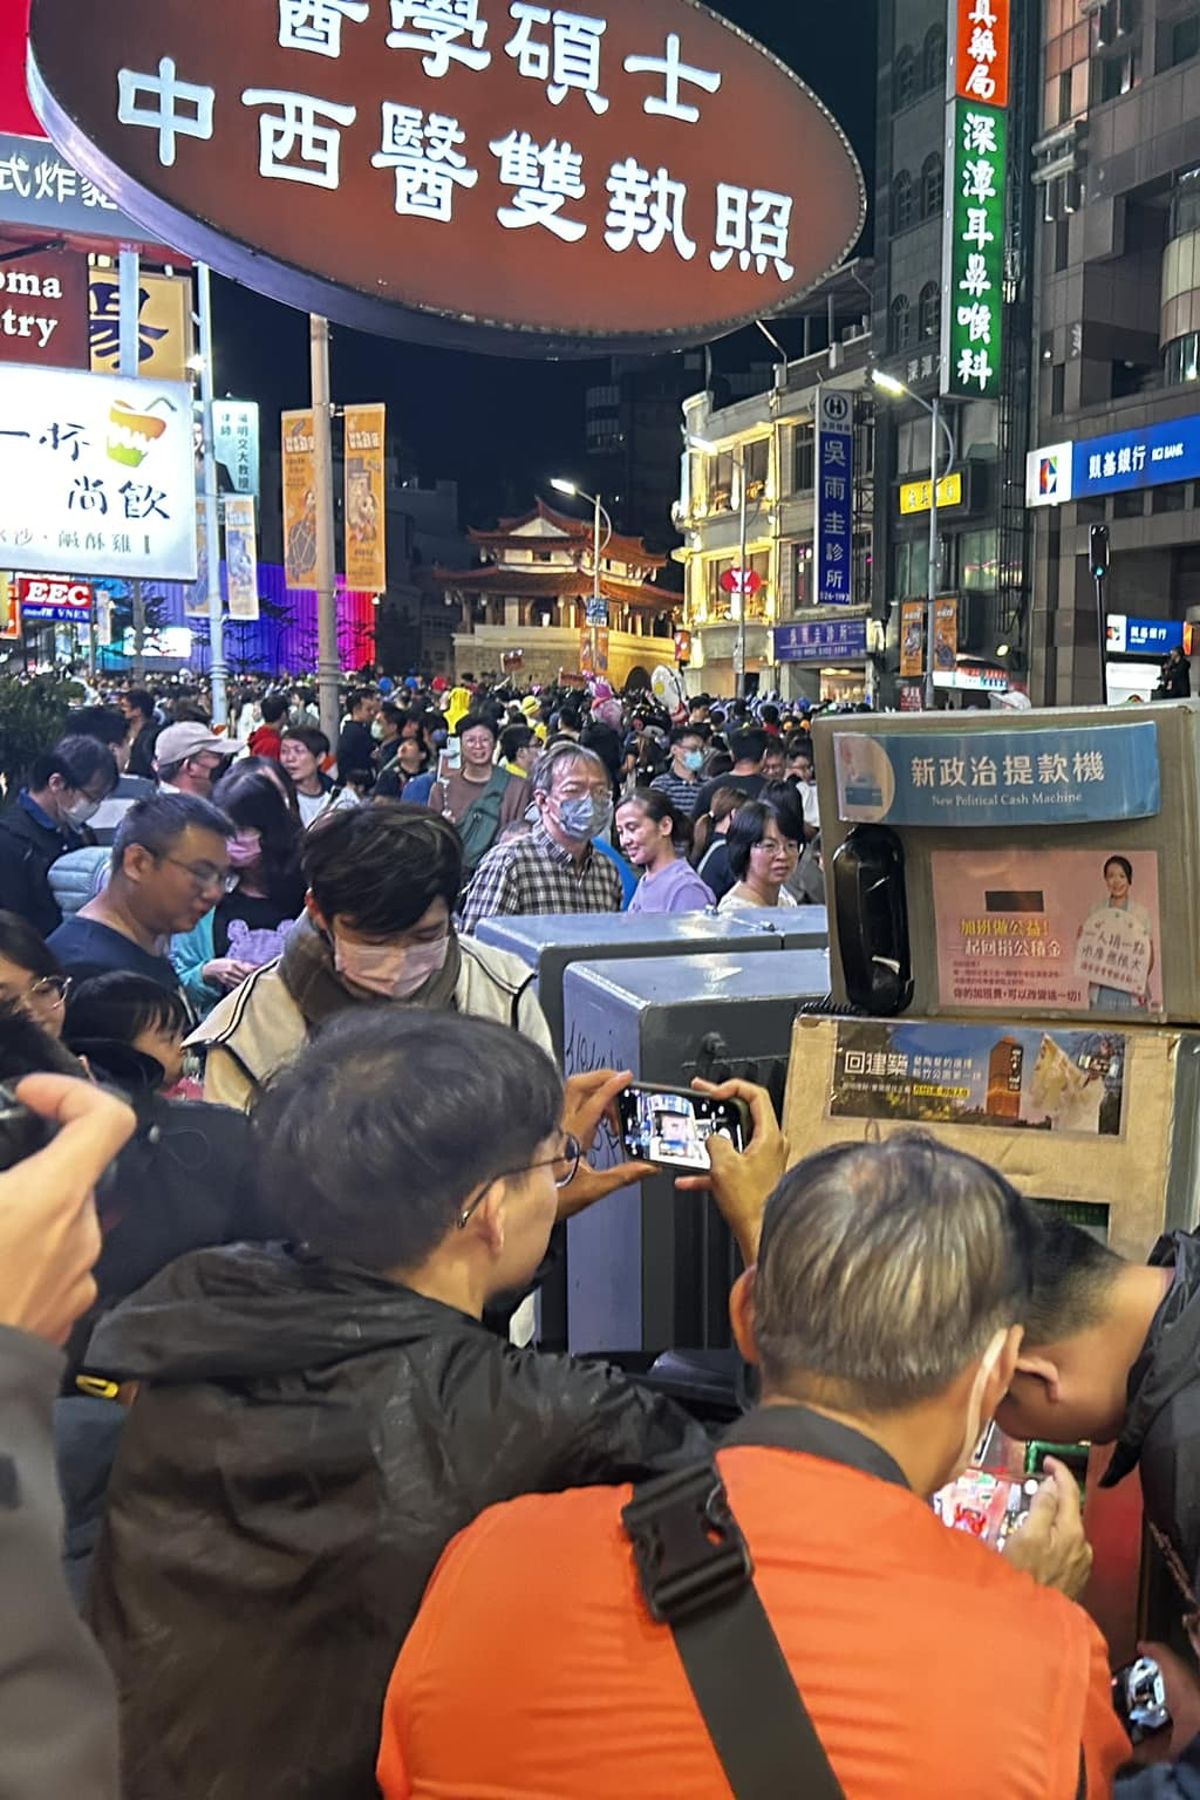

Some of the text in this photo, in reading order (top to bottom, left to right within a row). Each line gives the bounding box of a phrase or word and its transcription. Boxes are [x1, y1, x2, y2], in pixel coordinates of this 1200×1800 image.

[116, 56, 796, 282] 中西醫雙執照
[957, 112, 998, 391] 深潭耳鼻喉科
[68, 475, 170, 520] 尚飲
[823, 439, 847, 589] 吳雨圭診所
[911, 751, 1105, 788] 新政治提款機
[932, 790, 1083, 807] New Political Cash Machine
